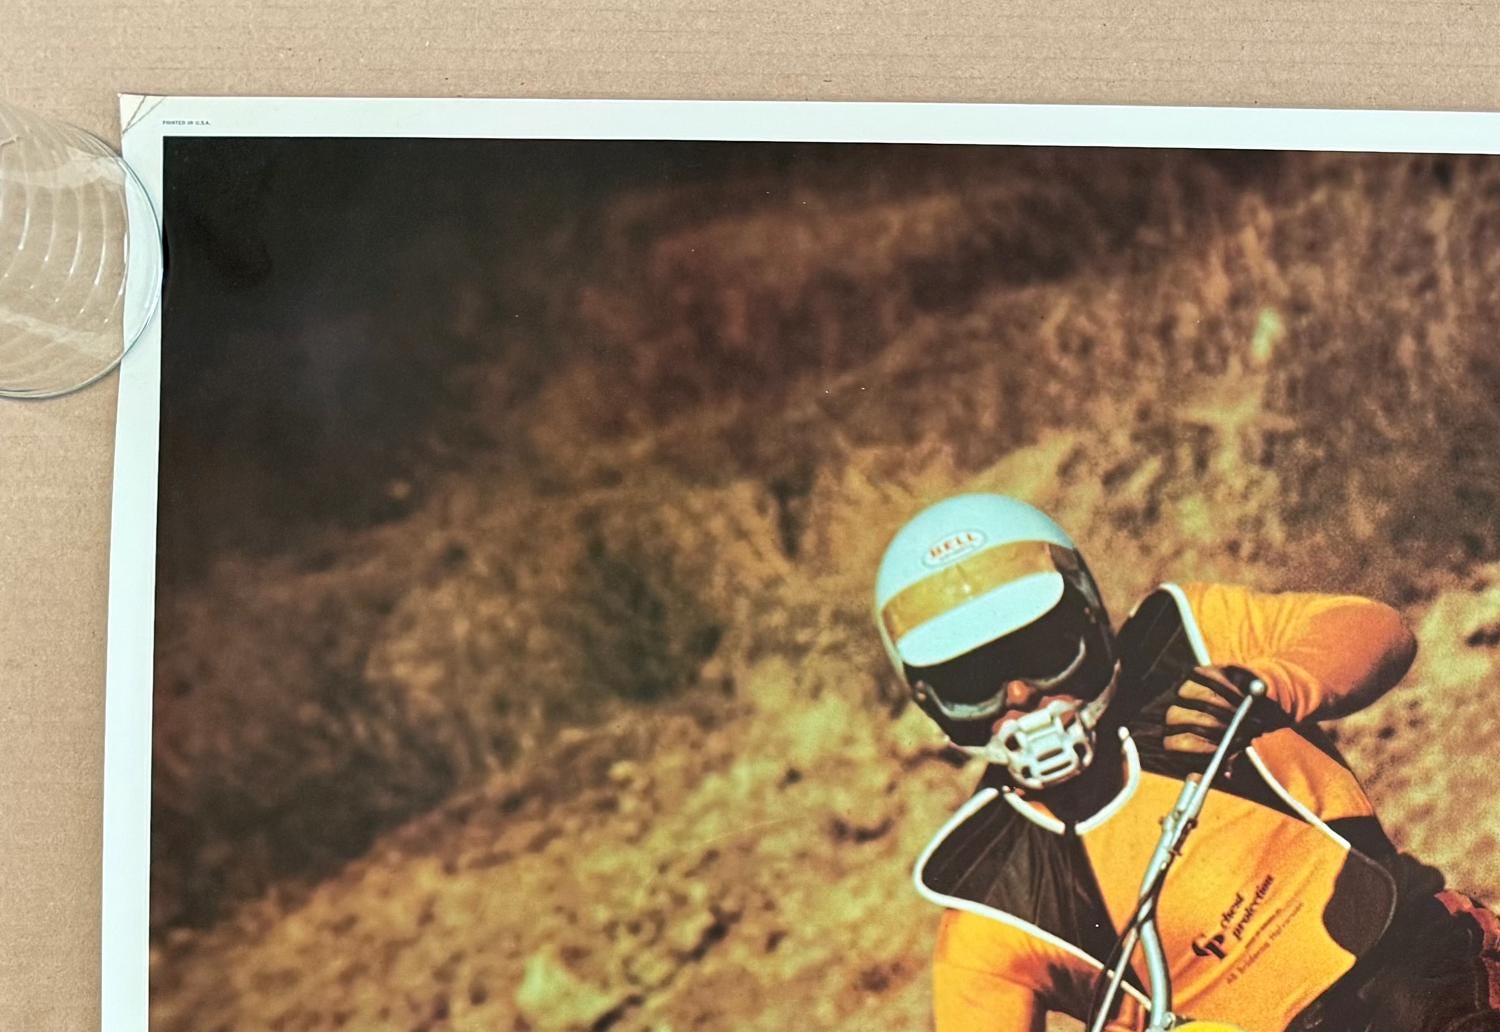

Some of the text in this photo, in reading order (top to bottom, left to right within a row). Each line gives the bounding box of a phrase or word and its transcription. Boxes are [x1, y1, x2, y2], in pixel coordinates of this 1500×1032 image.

[928, 531, 978, 560] BELL
[1219, 891, 1245, 929] chest
[1231, 873, 1275, 940] protection
